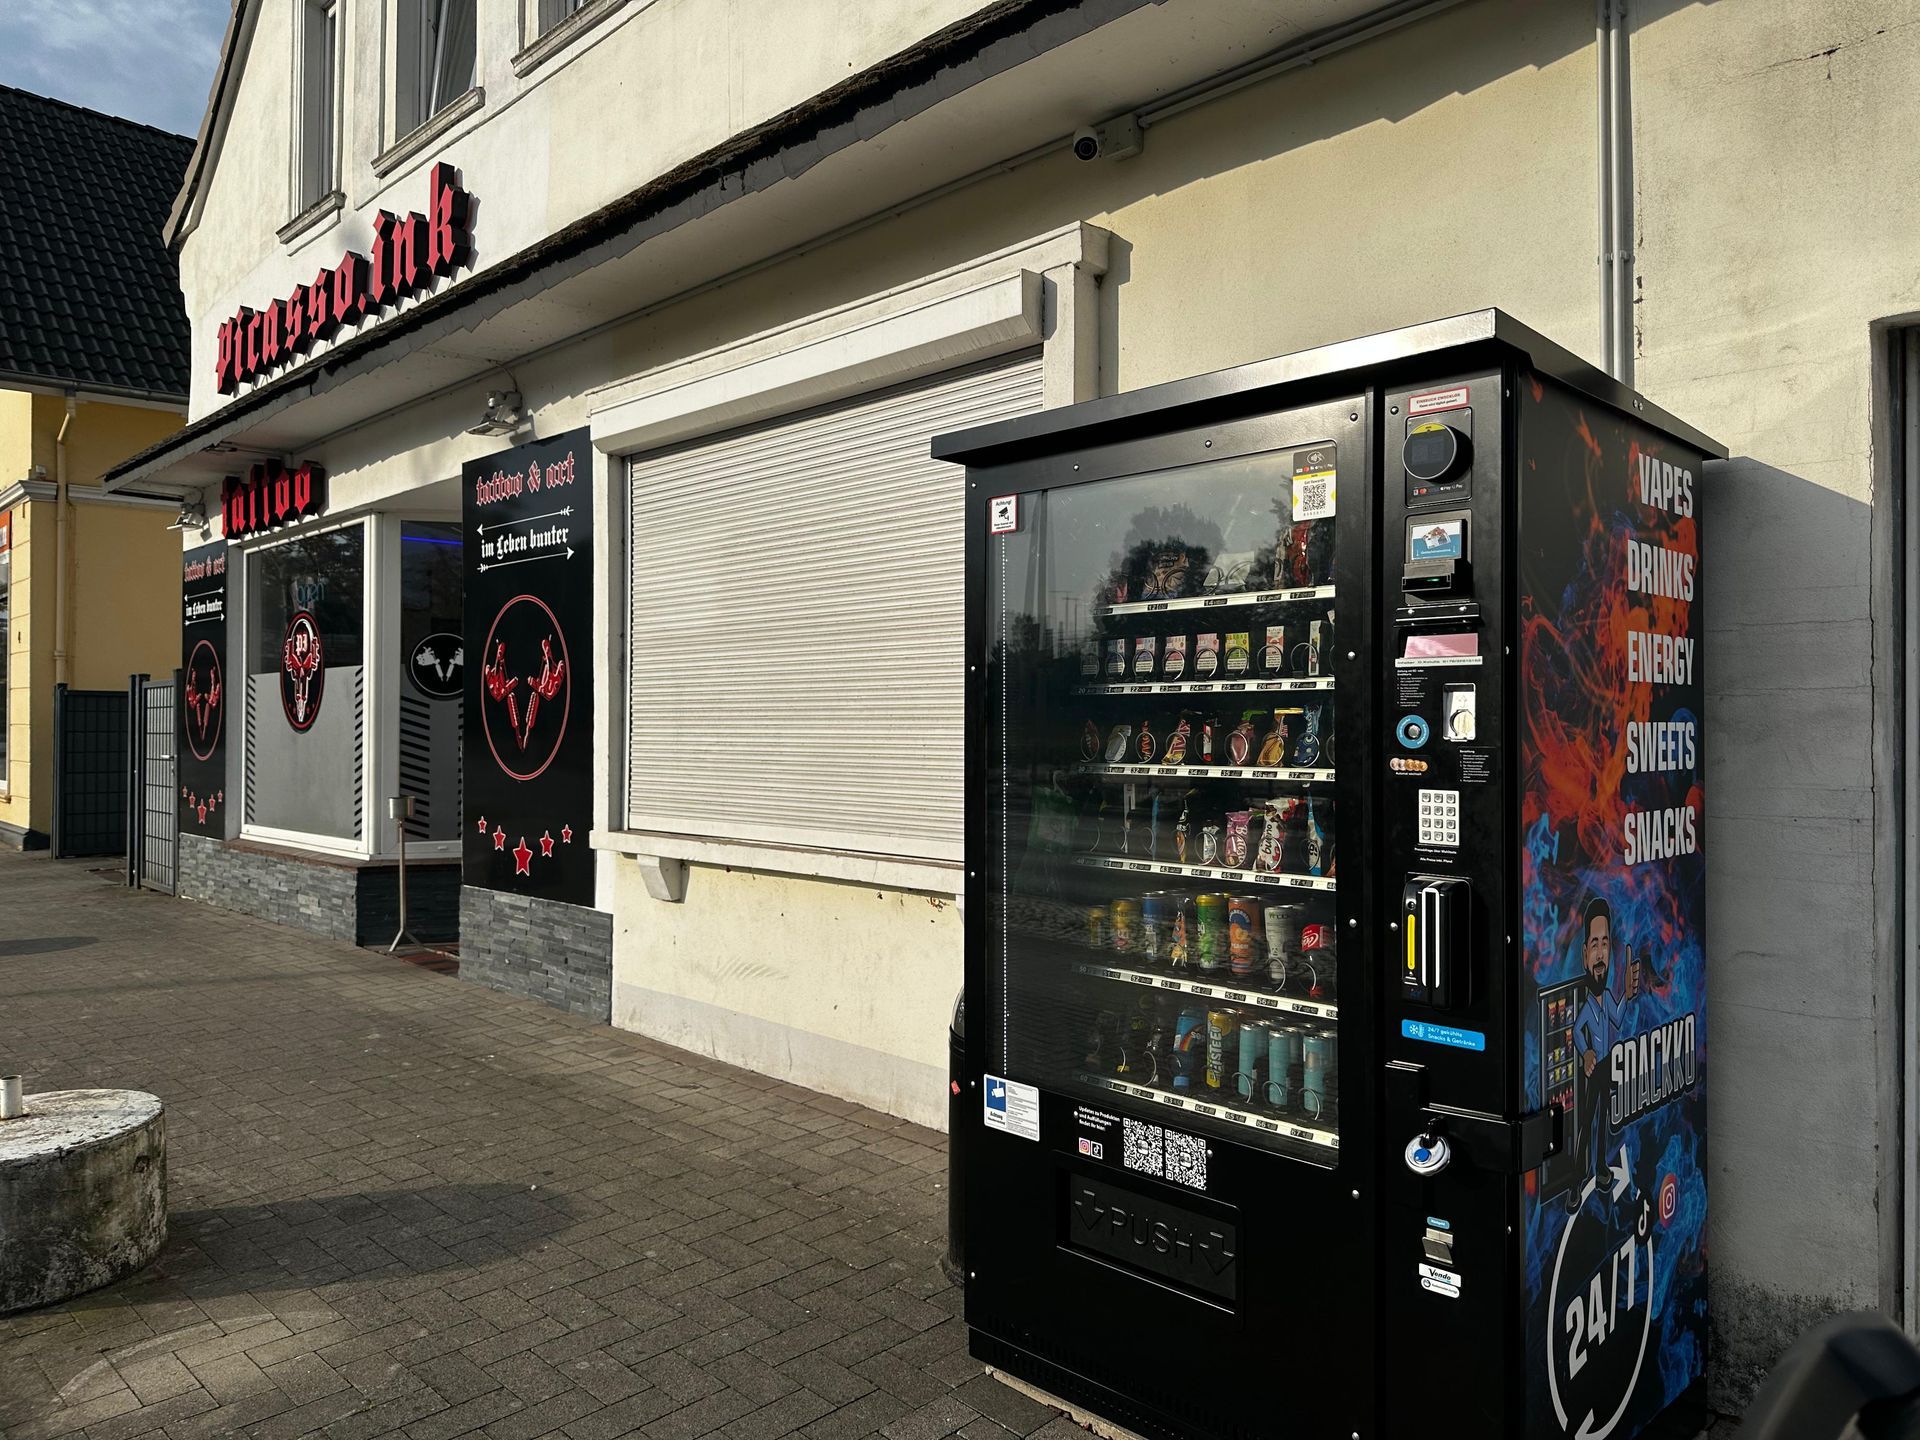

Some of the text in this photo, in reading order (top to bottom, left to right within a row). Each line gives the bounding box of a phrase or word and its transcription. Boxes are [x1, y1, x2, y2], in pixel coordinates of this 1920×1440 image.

[216, 162, 469, 394] picasso.ink
[221, 460, 318, 538] tattoo
[476, 451, 575, 506] tattoo & art
[1638, 453, 1694, 519] VAPES
[481, 525, 569, 560] im Leben bunter
[1627, 539, 1694, 602] DRINKS
[1627, 631, 1695, 686] ENERGY
[1626, 721, 1695, 773] SWEETS
[1261, 824, 1273, 855] bueno
[1624, 805, 1696, 866] SNACKS
[1427, 1033, 1446, 1042] Snacks
[1610, 1014, 1695, 1125] SNACKKO
[1111, 1206, 1192, 1264] PUSH
[1429, 1268, 1452, 1281] Vendo
[1566, 1234, 1635, 1380] 24/7
